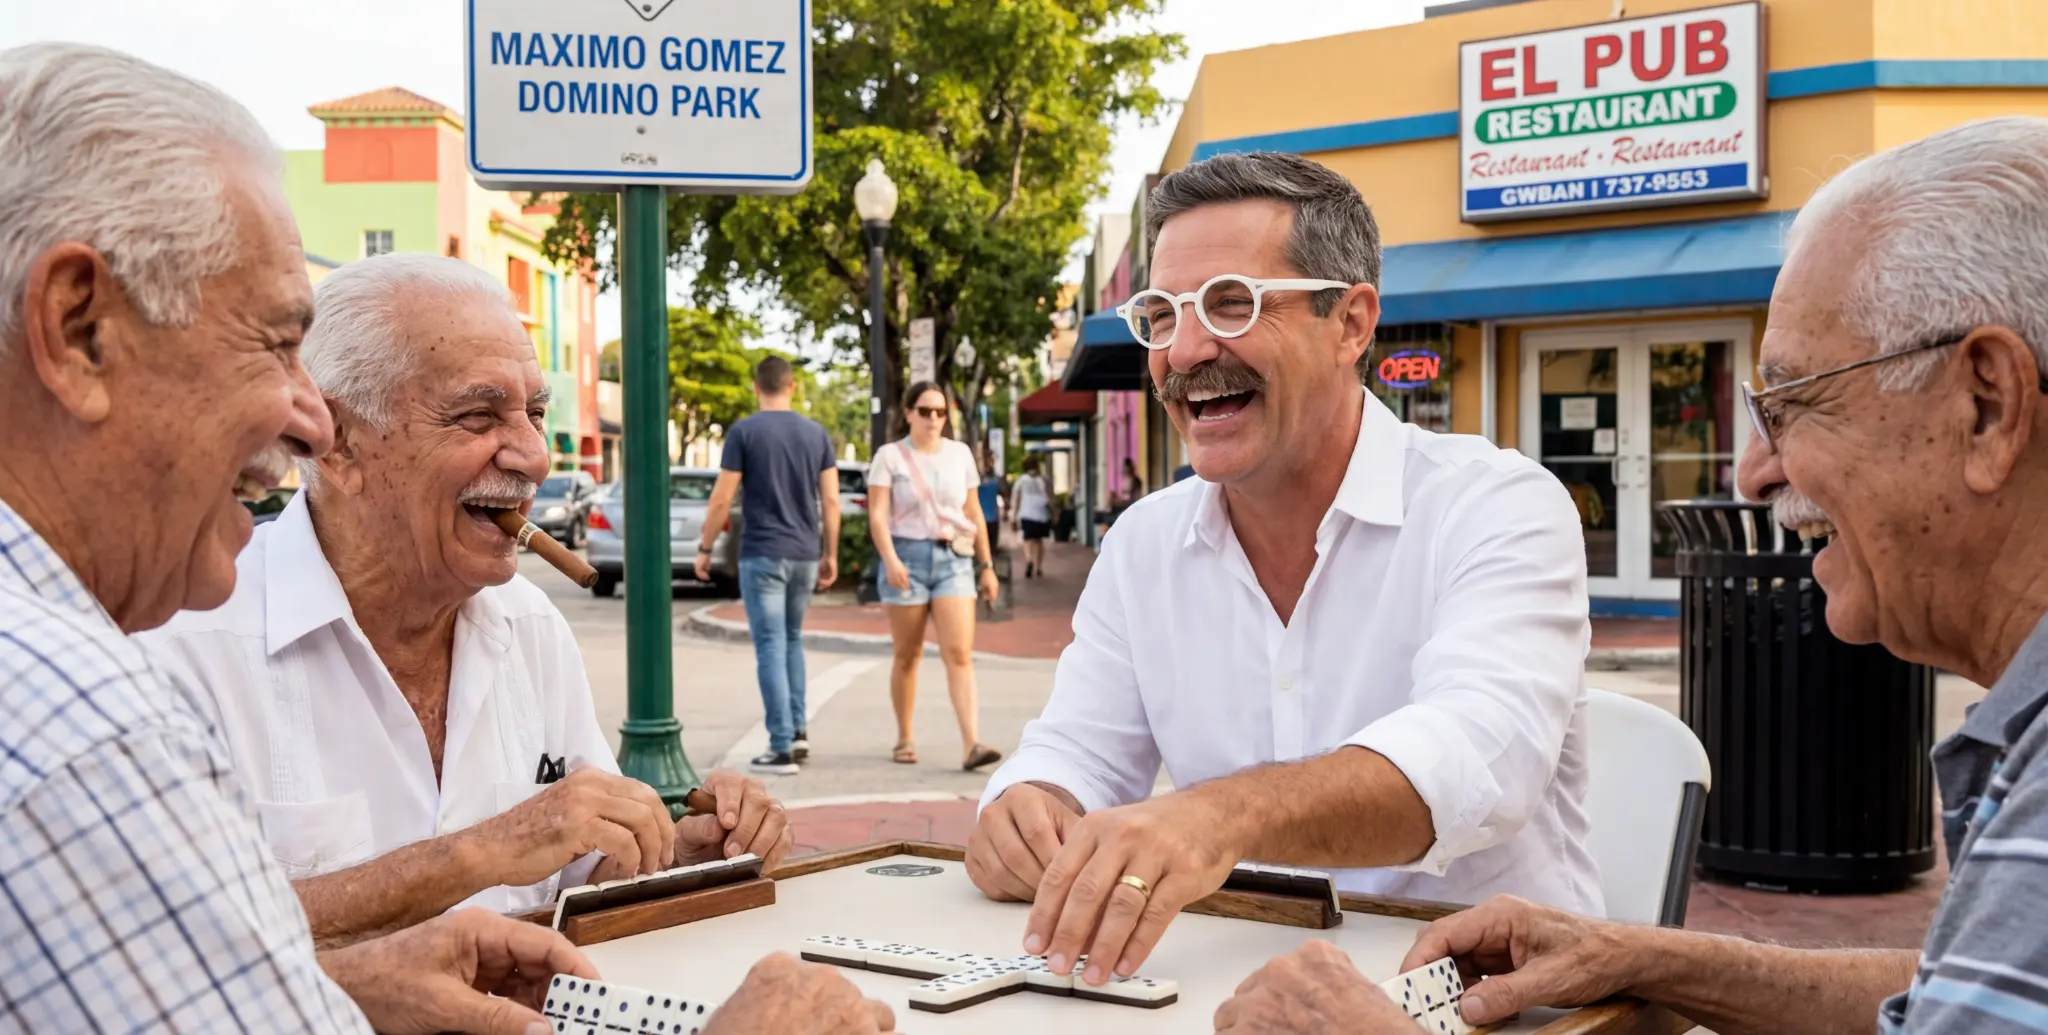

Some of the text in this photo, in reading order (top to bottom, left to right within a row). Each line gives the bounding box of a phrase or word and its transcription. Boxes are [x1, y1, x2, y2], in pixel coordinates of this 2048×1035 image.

[491, 31, 786, 74] MAXIMO GOMEZ
[1480, 19, 1729, 102] EL PUB
[519, 80, 761, 119] DOMINO PARK
[1487, 85, 1721, 140] RESTAURANT
[1468, 147, 1591, 180] Restaurant
[1610, 130, 1744, 167] Restaurant
[1604, 169, 1709, 196] 737-9553
[1378, 356, 1440, 381] OPEN
